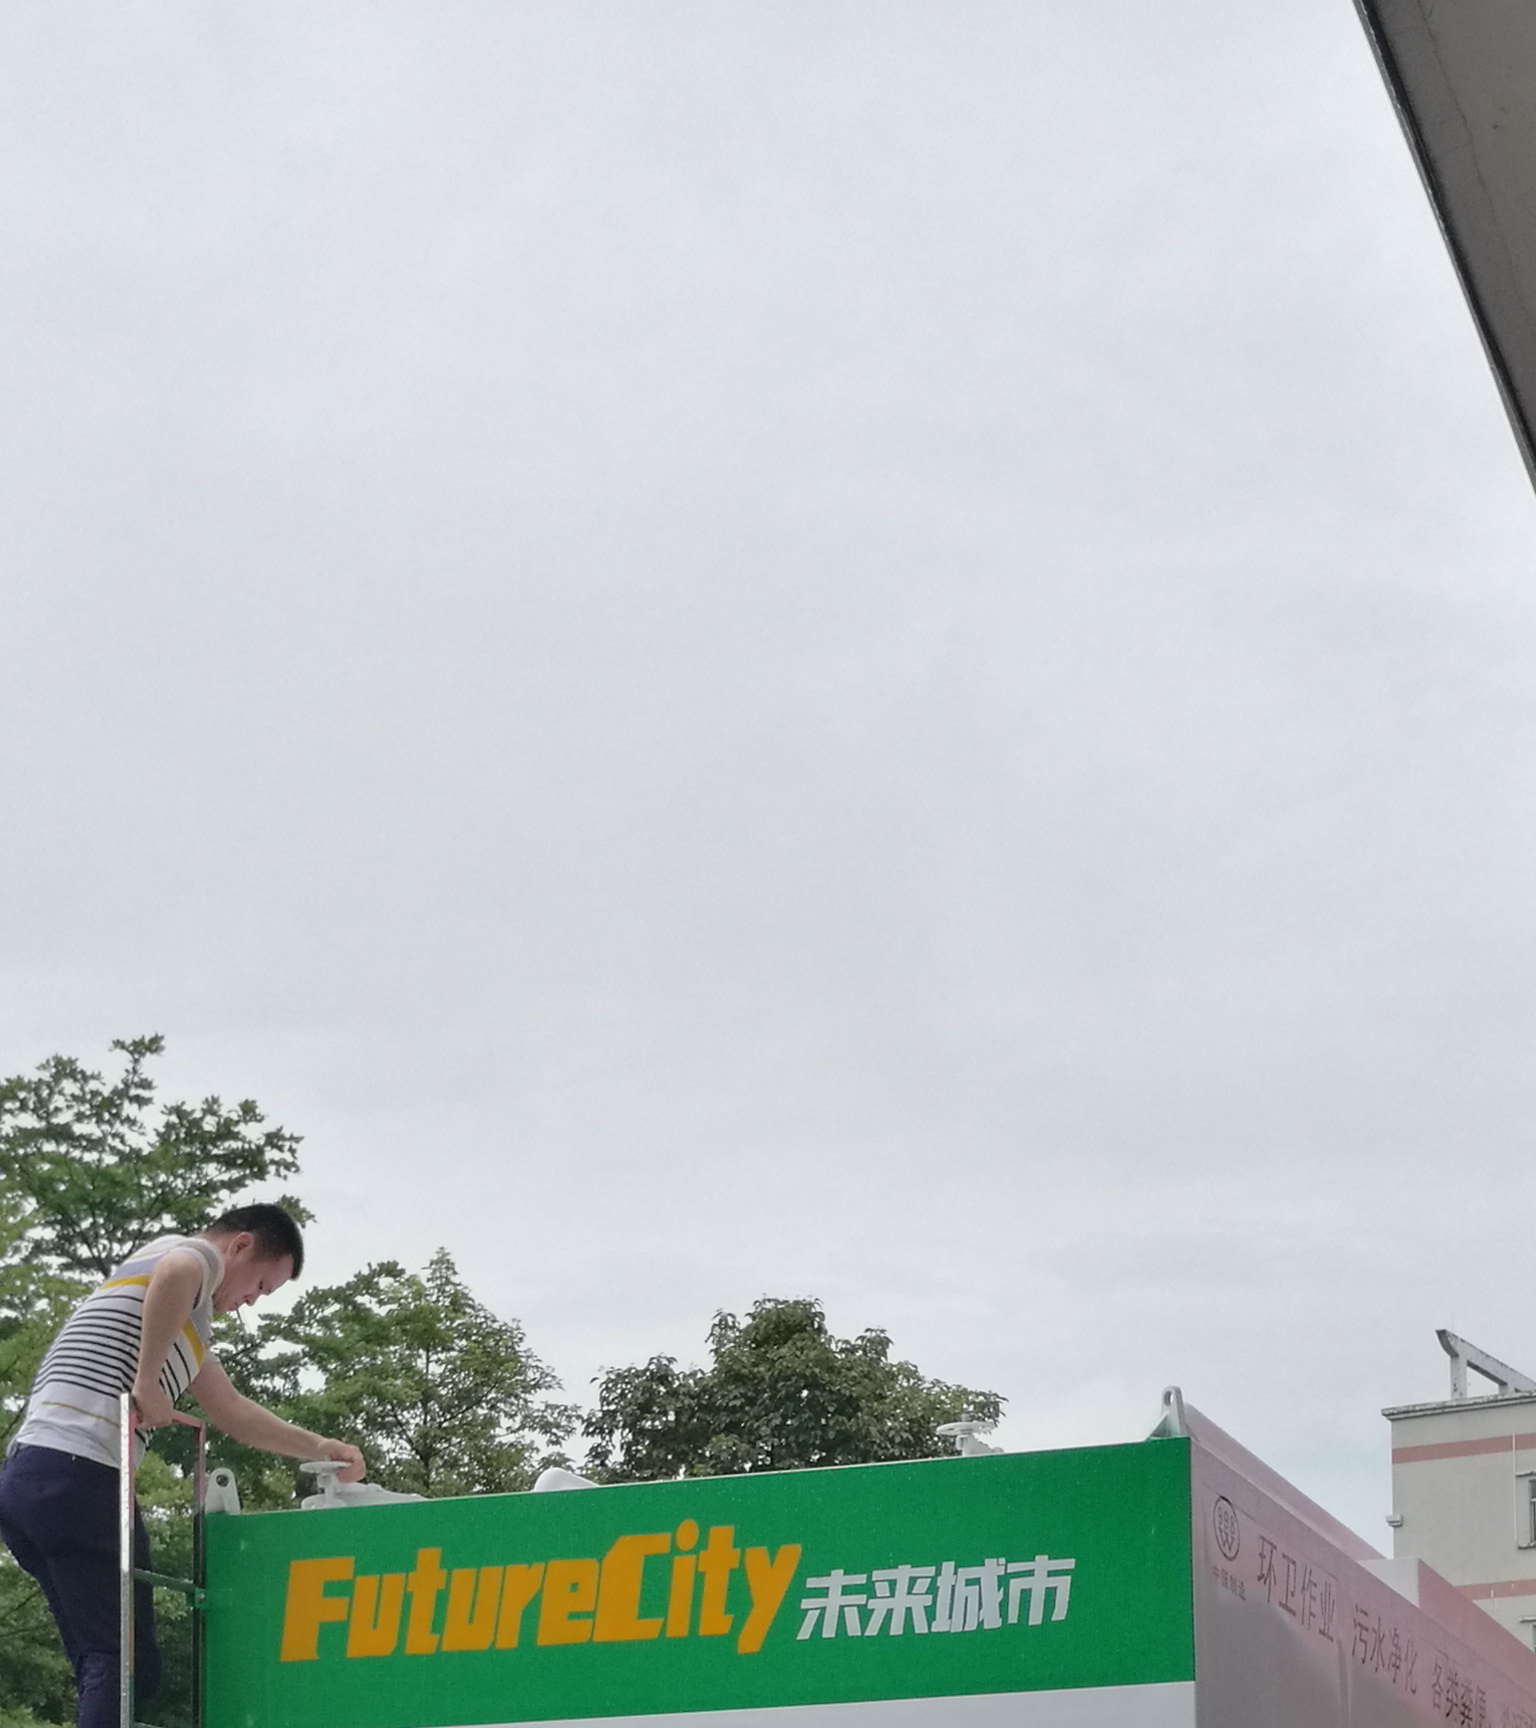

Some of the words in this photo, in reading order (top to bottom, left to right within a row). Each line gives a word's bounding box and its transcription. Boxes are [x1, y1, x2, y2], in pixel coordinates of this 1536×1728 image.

[279, 1518, 802, 1662] FutureCity
[796, 1553, 1076, 1641] 未来城市
[1256, 1534, 1336, 1641] 环卫作业
[1351, 1603, 1418, 1696] 污水净化
